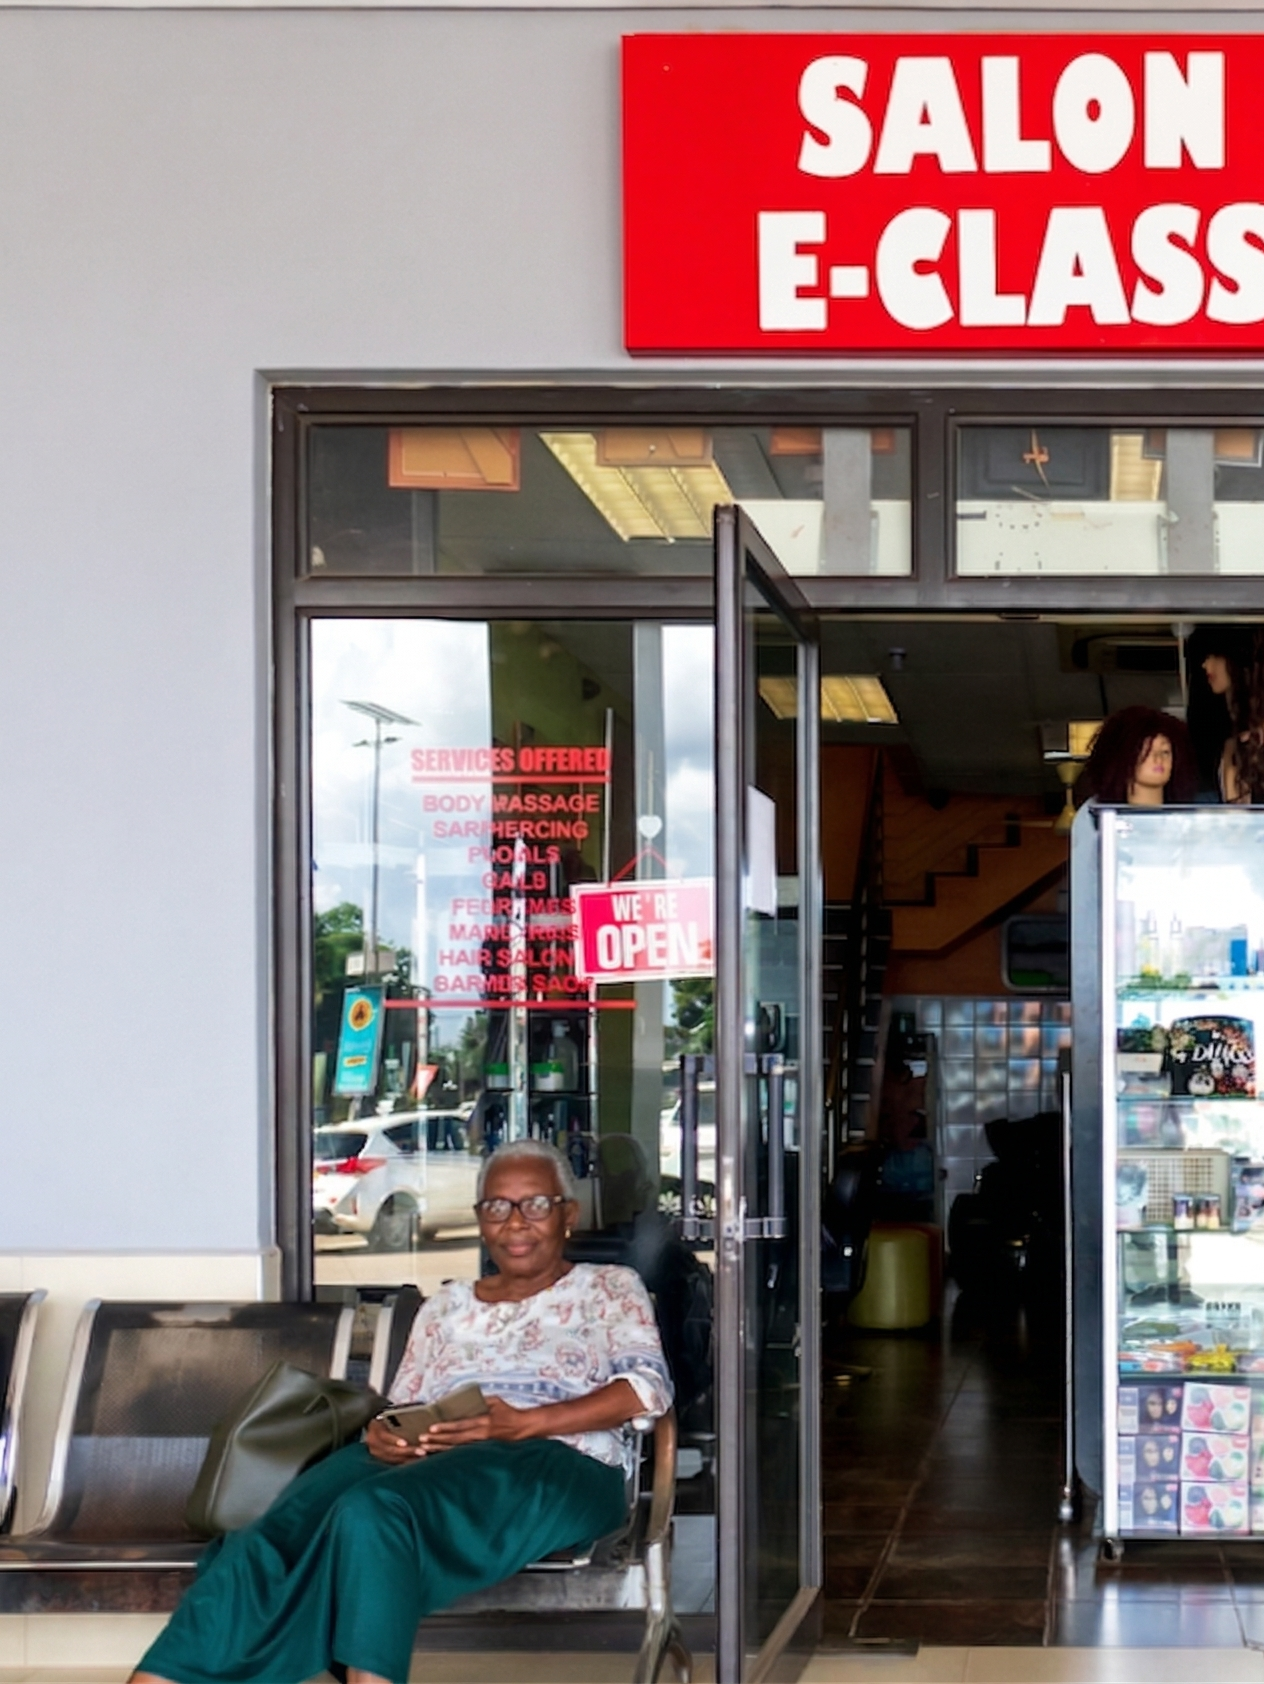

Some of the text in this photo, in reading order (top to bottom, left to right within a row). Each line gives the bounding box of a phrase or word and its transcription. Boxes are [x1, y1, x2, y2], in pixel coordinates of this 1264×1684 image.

[798, 51, 1225, 178] SALON
[410, 747, 611, 772] SERVICES OFFERED
[422, 793, 601, 813] BODY MASSAGE
[610, 892, 679, 922] WE'RE
[438, 948, 575, 968] HAIR SALON
[596, 919, 699, 970] OPEN
